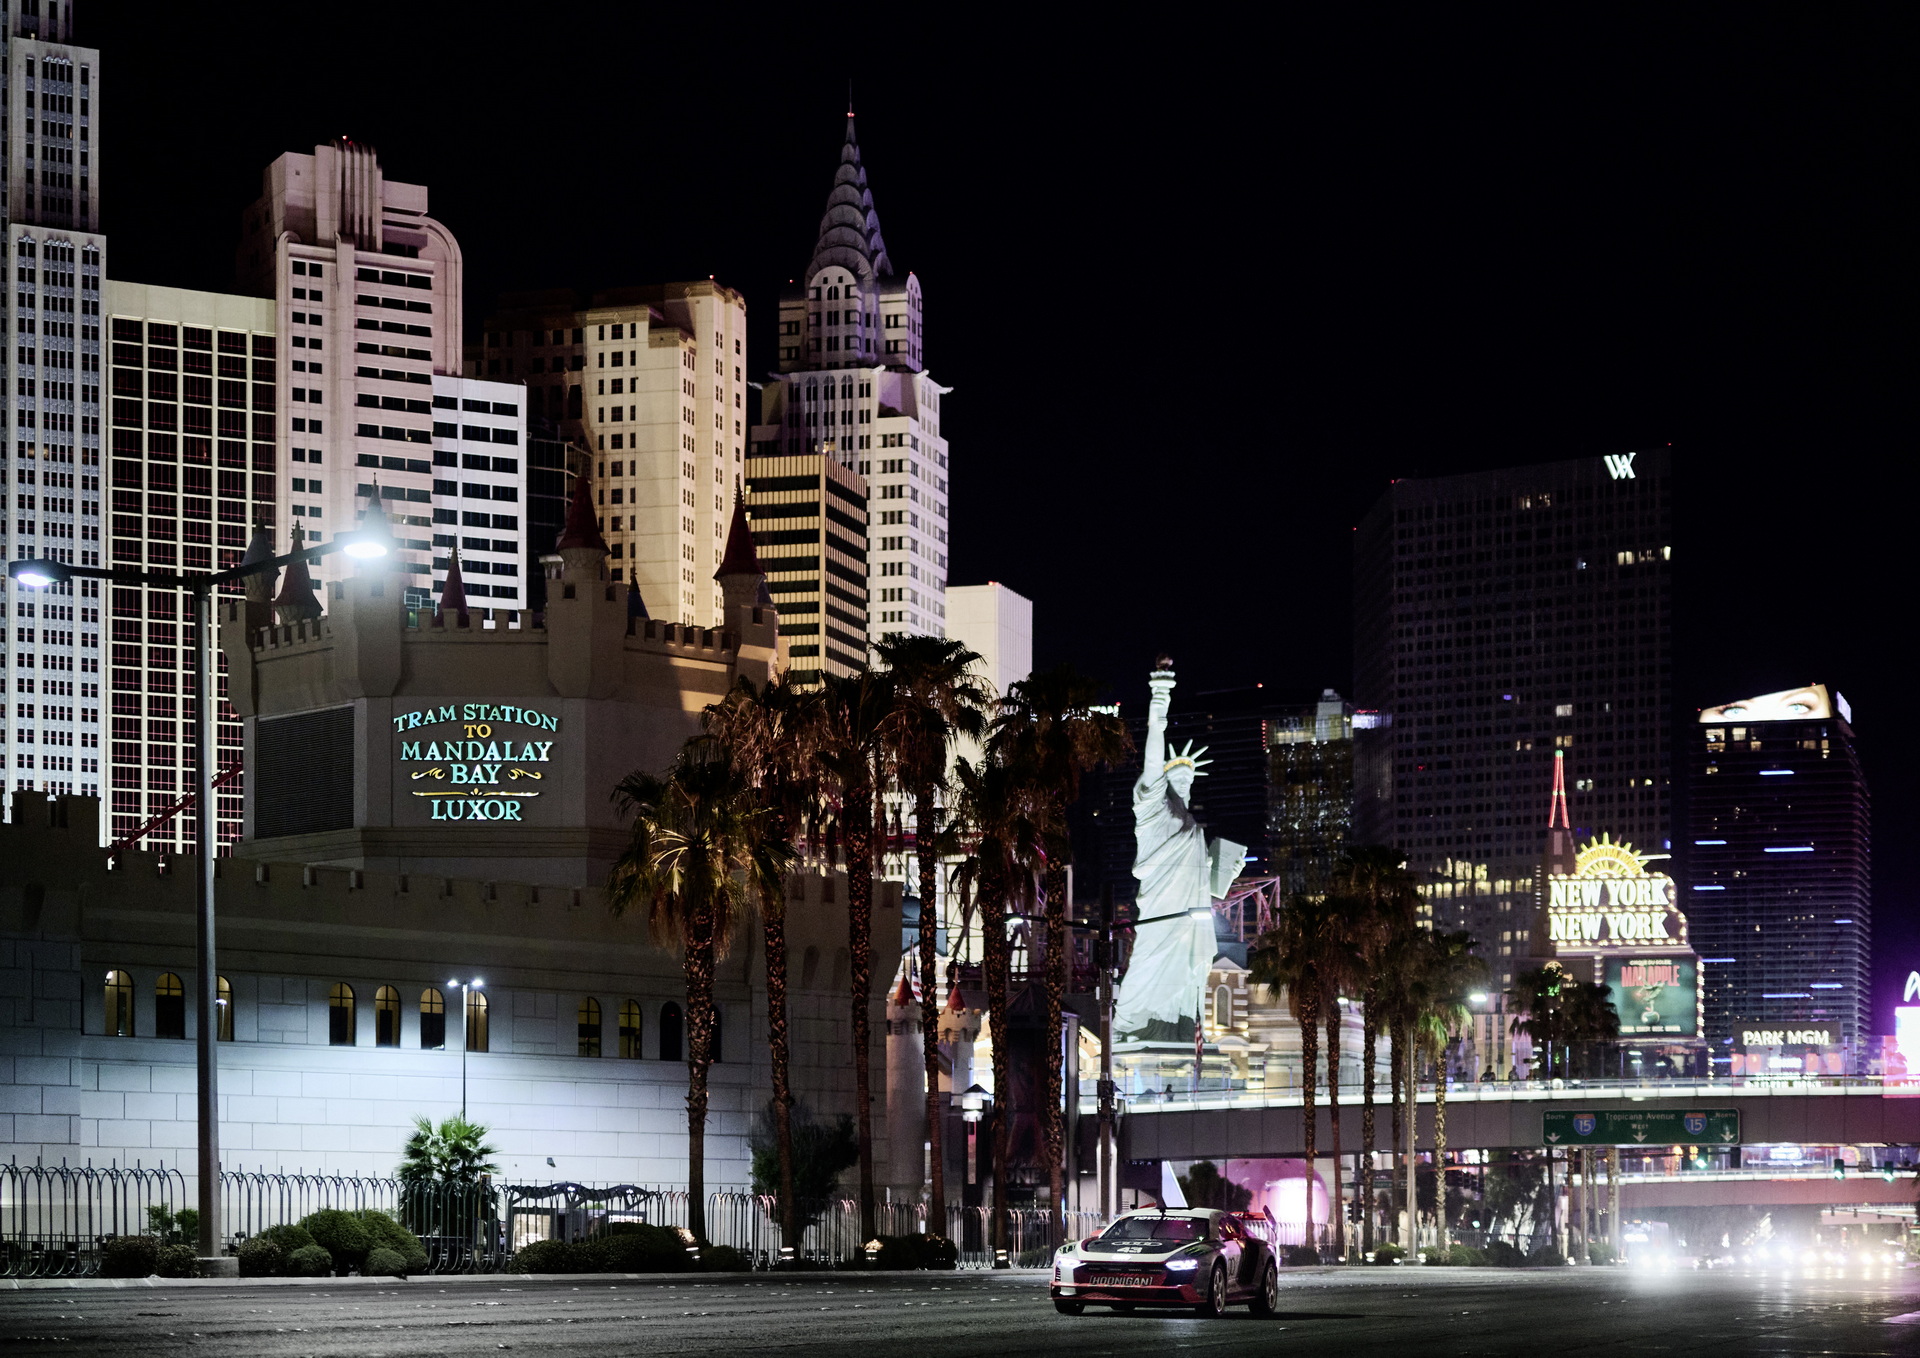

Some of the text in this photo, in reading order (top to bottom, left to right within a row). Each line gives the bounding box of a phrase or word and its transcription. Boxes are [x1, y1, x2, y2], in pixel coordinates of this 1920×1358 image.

[394, 703, 559, 733] TRAM STATION
[464, 724, 492, 739] TO
[400, 741, 553, 762] MANDALAY
[450, 763, 502, 784] BAY
[431, 799, 522, 821] LUXOR
[1549, 879, 1669, 907] NEW YORK
[1549, 911, 1669, 940] NEW YORK
[1647, 965, 1680, 987] APPLE
[1742, 1030, 1830, 1046] PARK MGM
[1579, 1119, 1592, 1132] 15
[1605, 1112, 1676, 1121] Tropicana Avenue
[1690, 1118, 1703, 1131] 15
